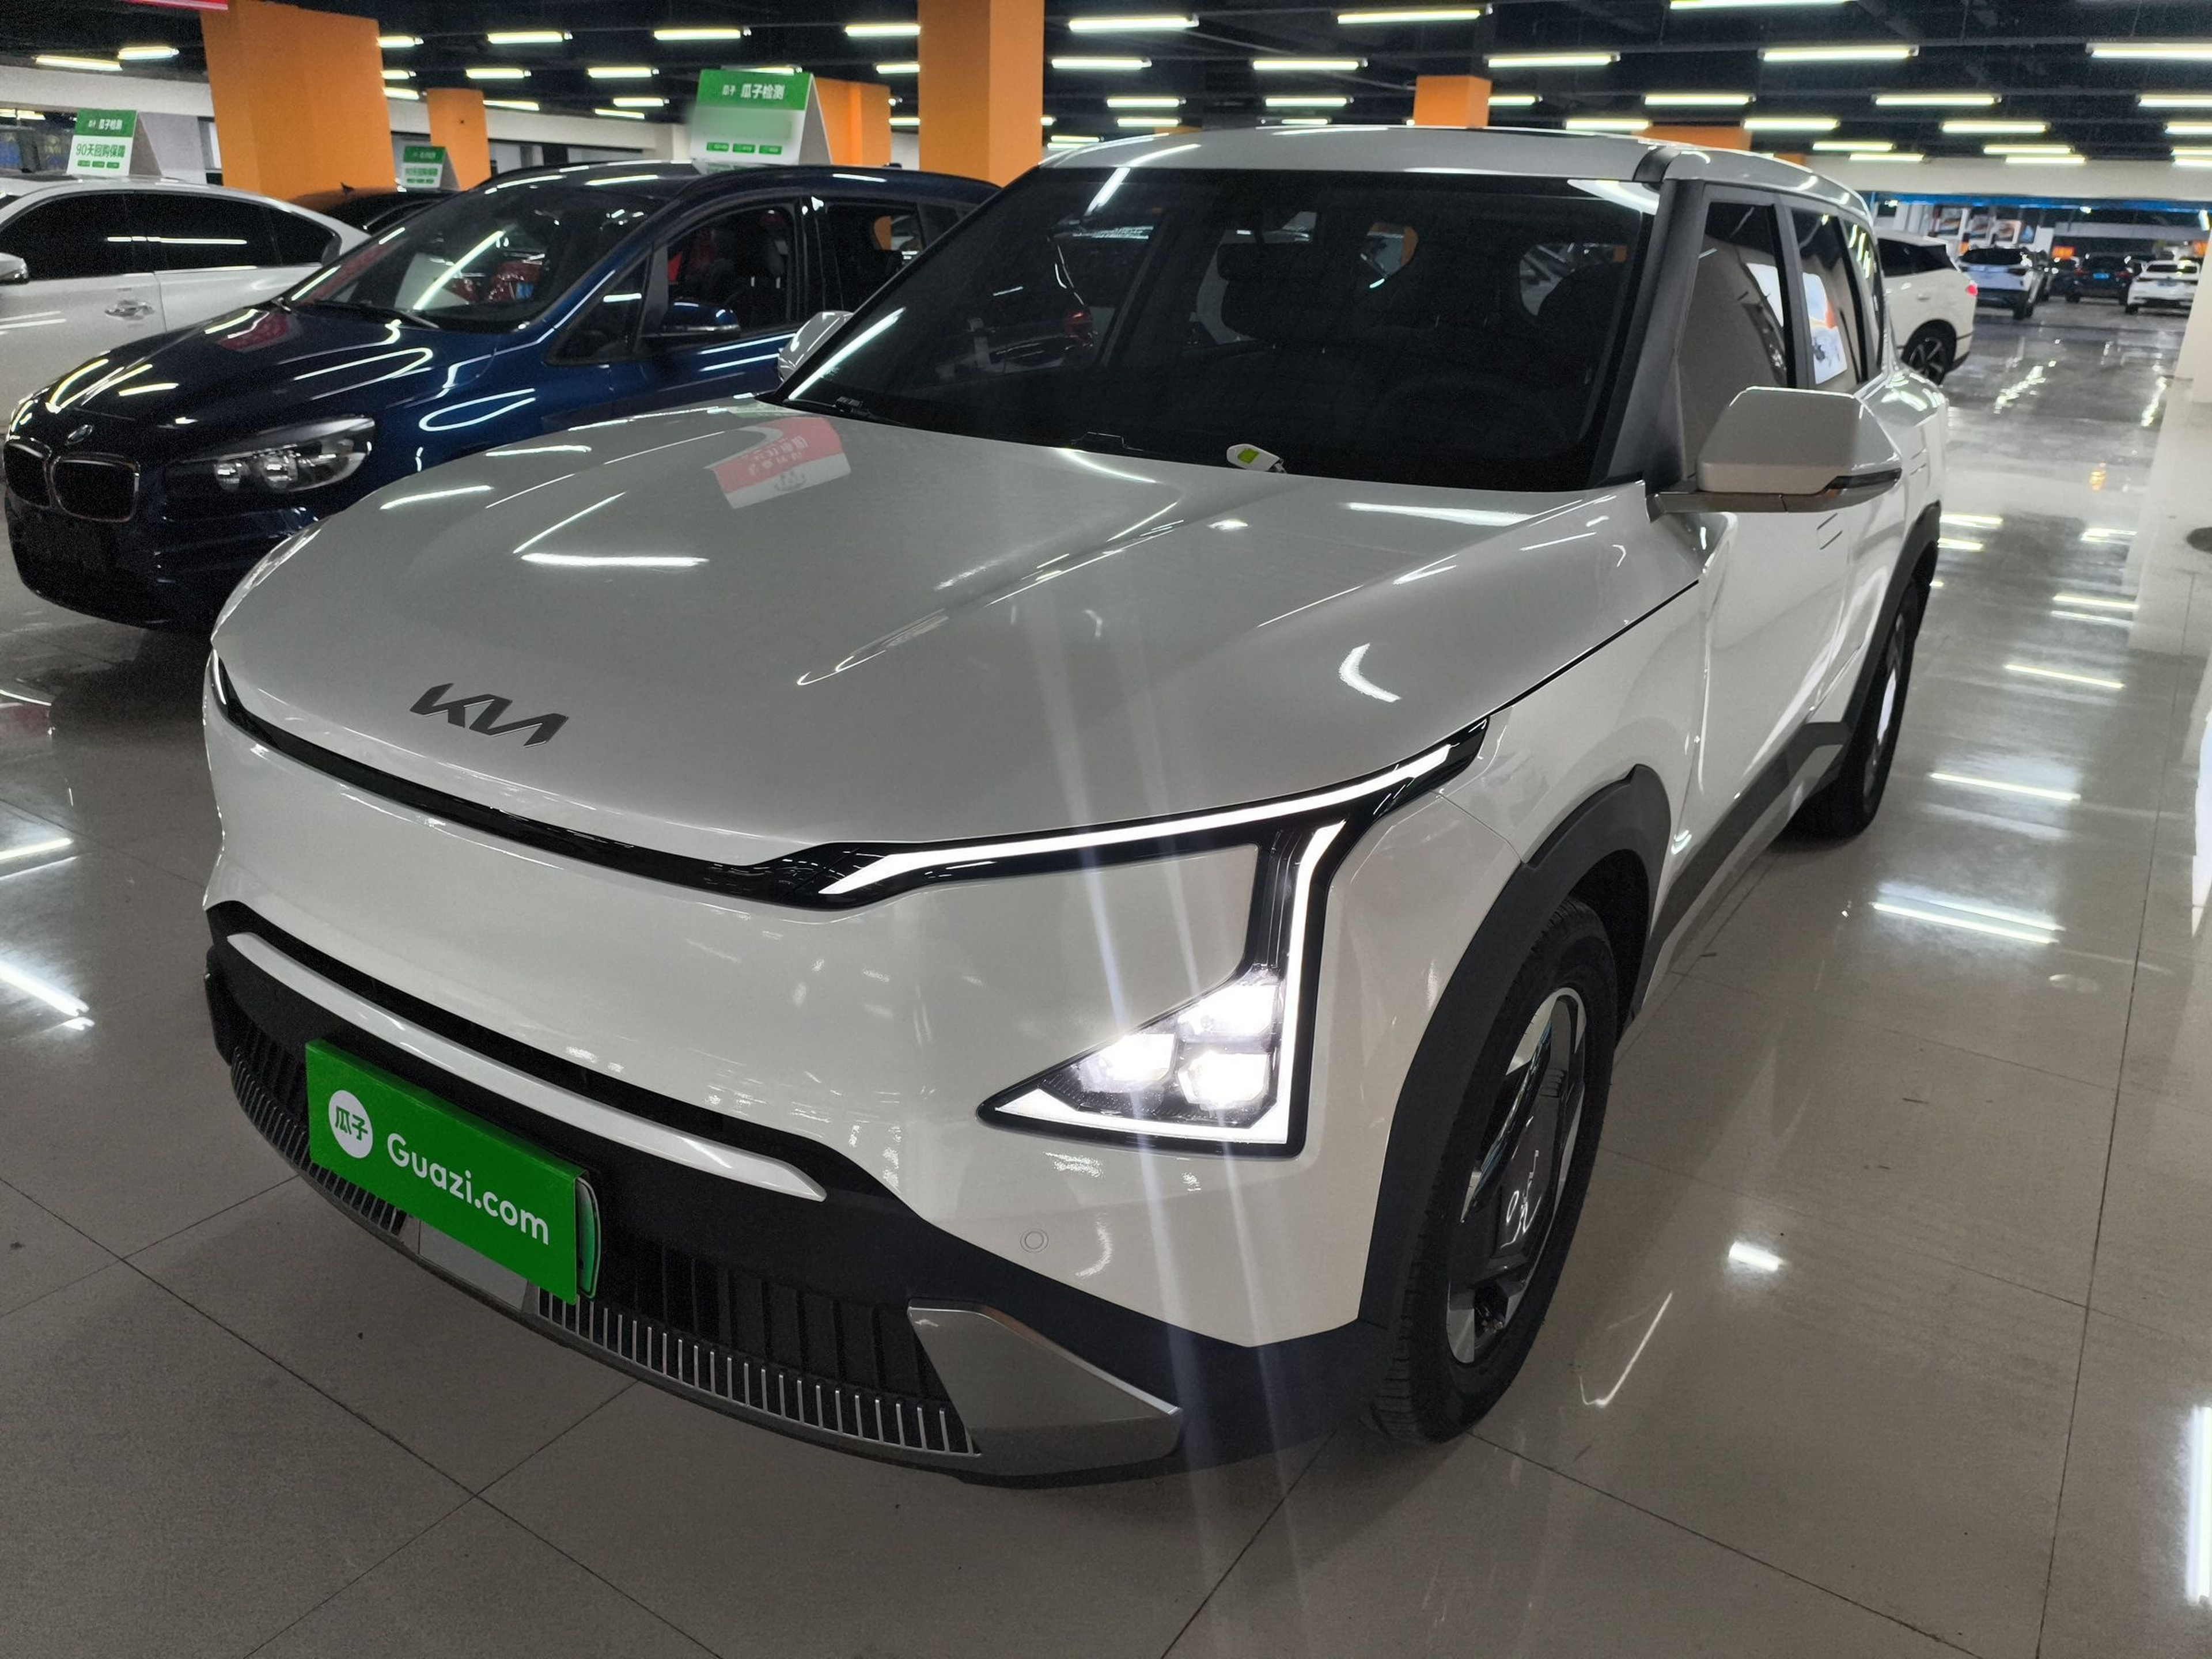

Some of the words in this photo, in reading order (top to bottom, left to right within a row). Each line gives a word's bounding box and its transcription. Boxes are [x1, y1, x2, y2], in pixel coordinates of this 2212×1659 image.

[740, 84, 785, 100] 瓜子检测
[410, 683, 569, 748] KIA
[335, 1105, 368, 1141] 瓜子
[387, 1132, 549, 1246] Guazi.com
